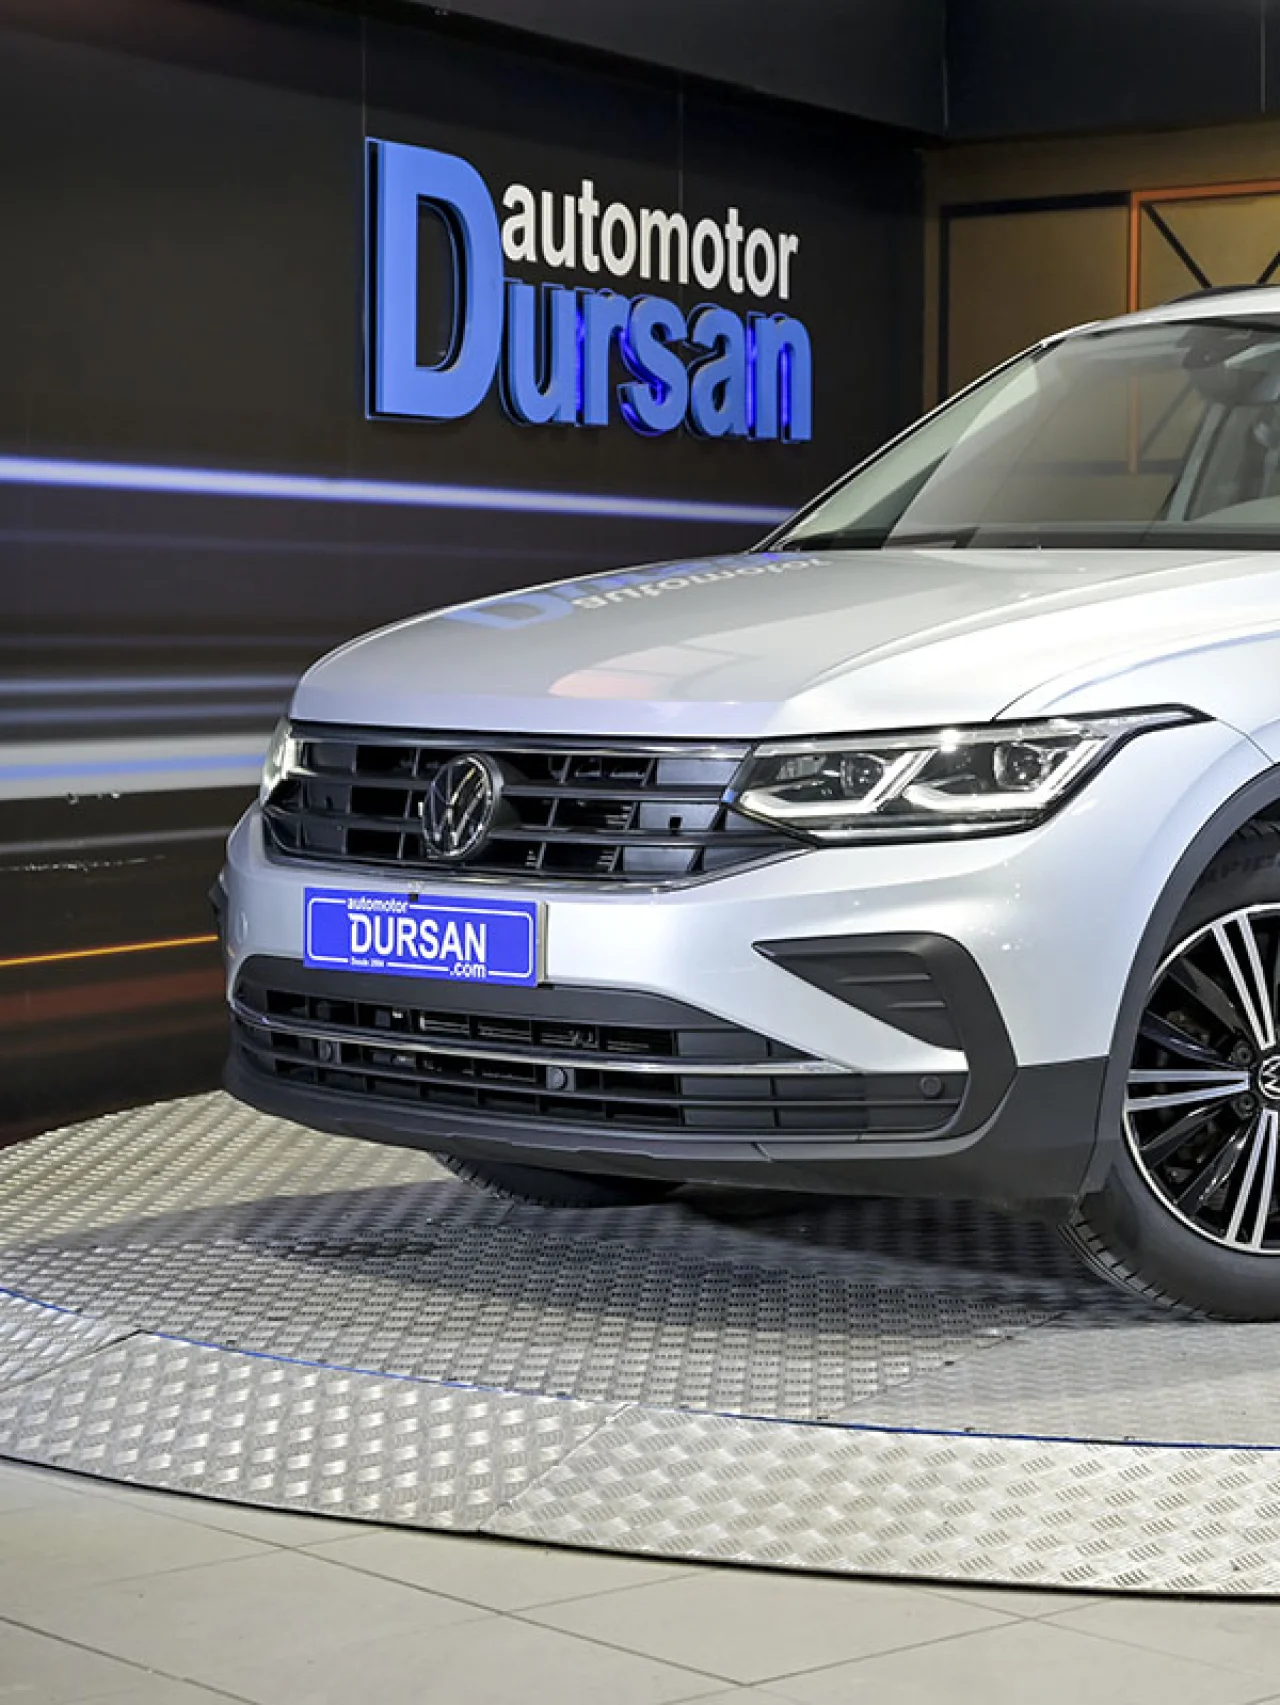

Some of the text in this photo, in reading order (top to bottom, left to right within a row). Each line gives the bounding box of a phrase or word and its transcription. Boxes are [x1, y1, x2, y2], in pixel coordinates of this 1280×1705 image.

[502, 179, 799, 299] automotor
[365, 137, 812, 442] Dursan
[347, 913, 487, 963] DURSAN
[450, 962, 487, 978] .com
